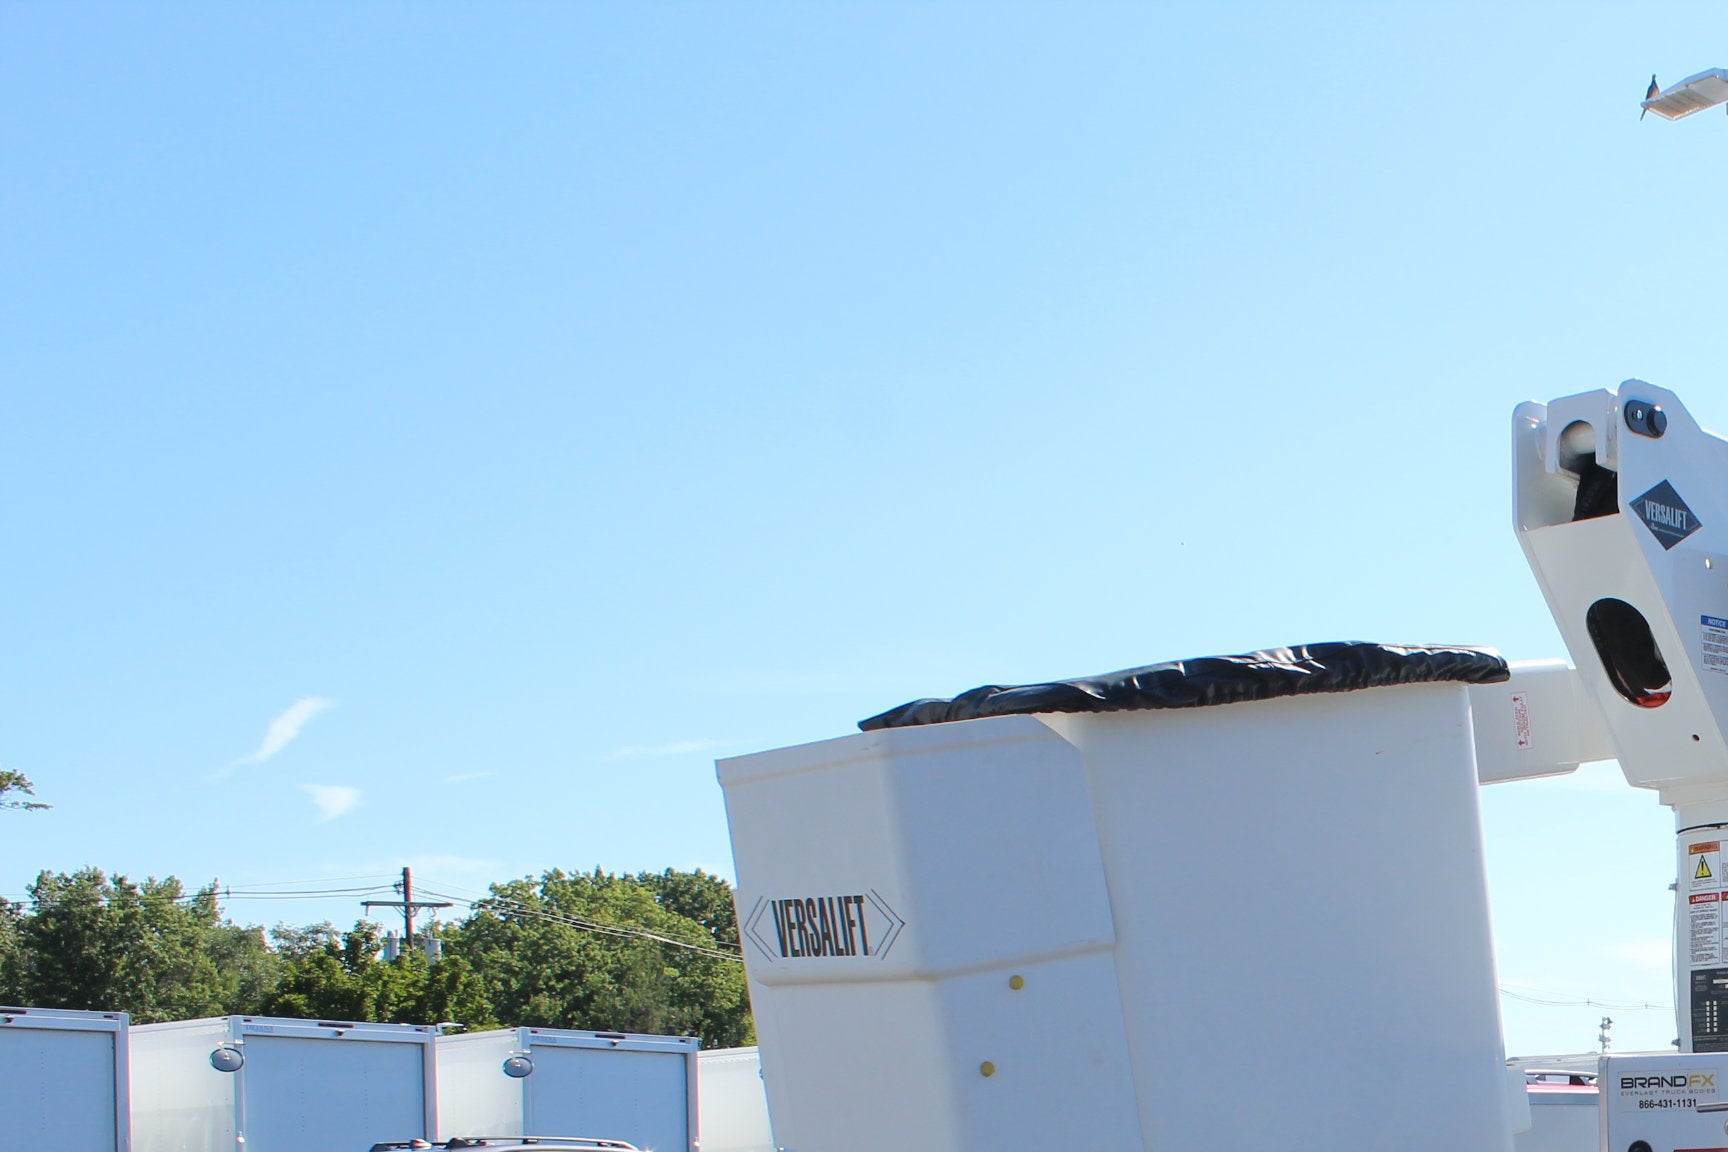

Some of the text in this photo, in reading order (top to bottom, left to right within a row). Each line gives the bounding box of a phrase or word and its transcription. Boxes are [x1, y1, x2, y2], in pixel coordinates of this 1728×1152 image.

[1645, 499, 1688, 530] VERSALIFT
[1707, 618, 1727, 628] NOTICE
[1695, 895, 1717, 903] DANGER
[771, 894, 870, 958] VERSALIFT
[1638, 1098, 1697, 1109] 866-431-1131
